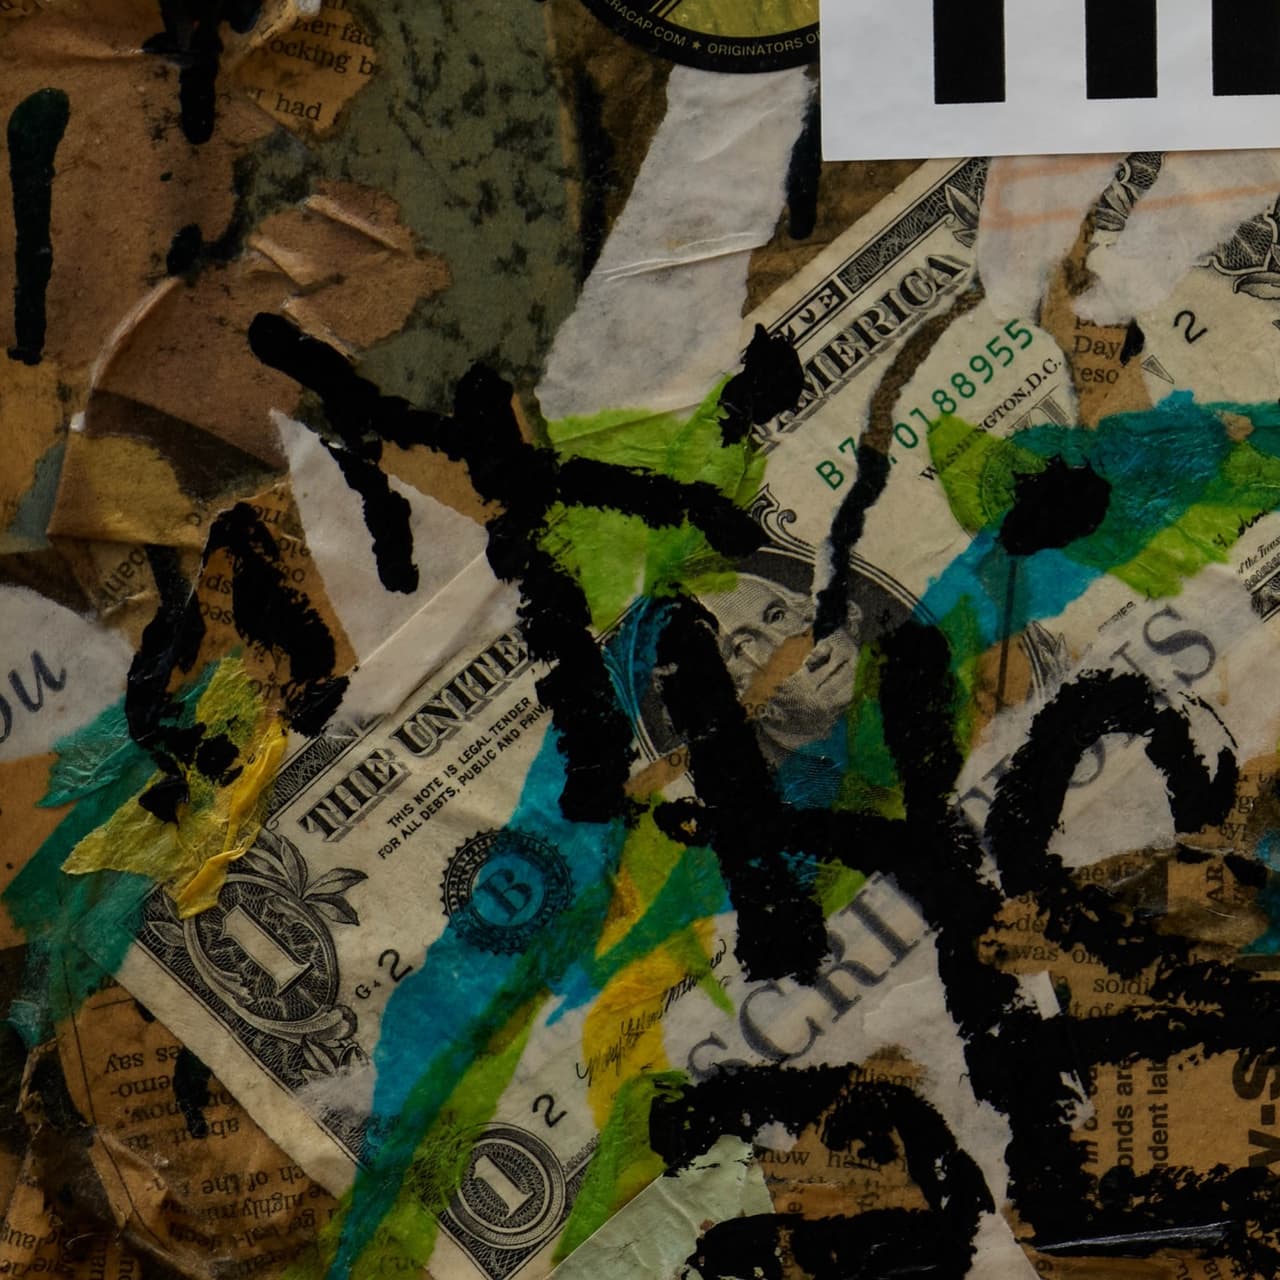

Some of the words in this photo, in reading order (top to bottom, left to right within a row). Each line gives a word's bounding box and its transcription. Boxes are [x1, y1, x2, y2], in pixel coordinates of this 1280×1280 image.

[706, 38, 805, 57] ORIGINATORS
[775, 254, 973, 435] MERICA
[296, 749, 411, 843] THE
[388, 630, 532, 758] UNITE
[487, 696, 532, 736] TENDER
